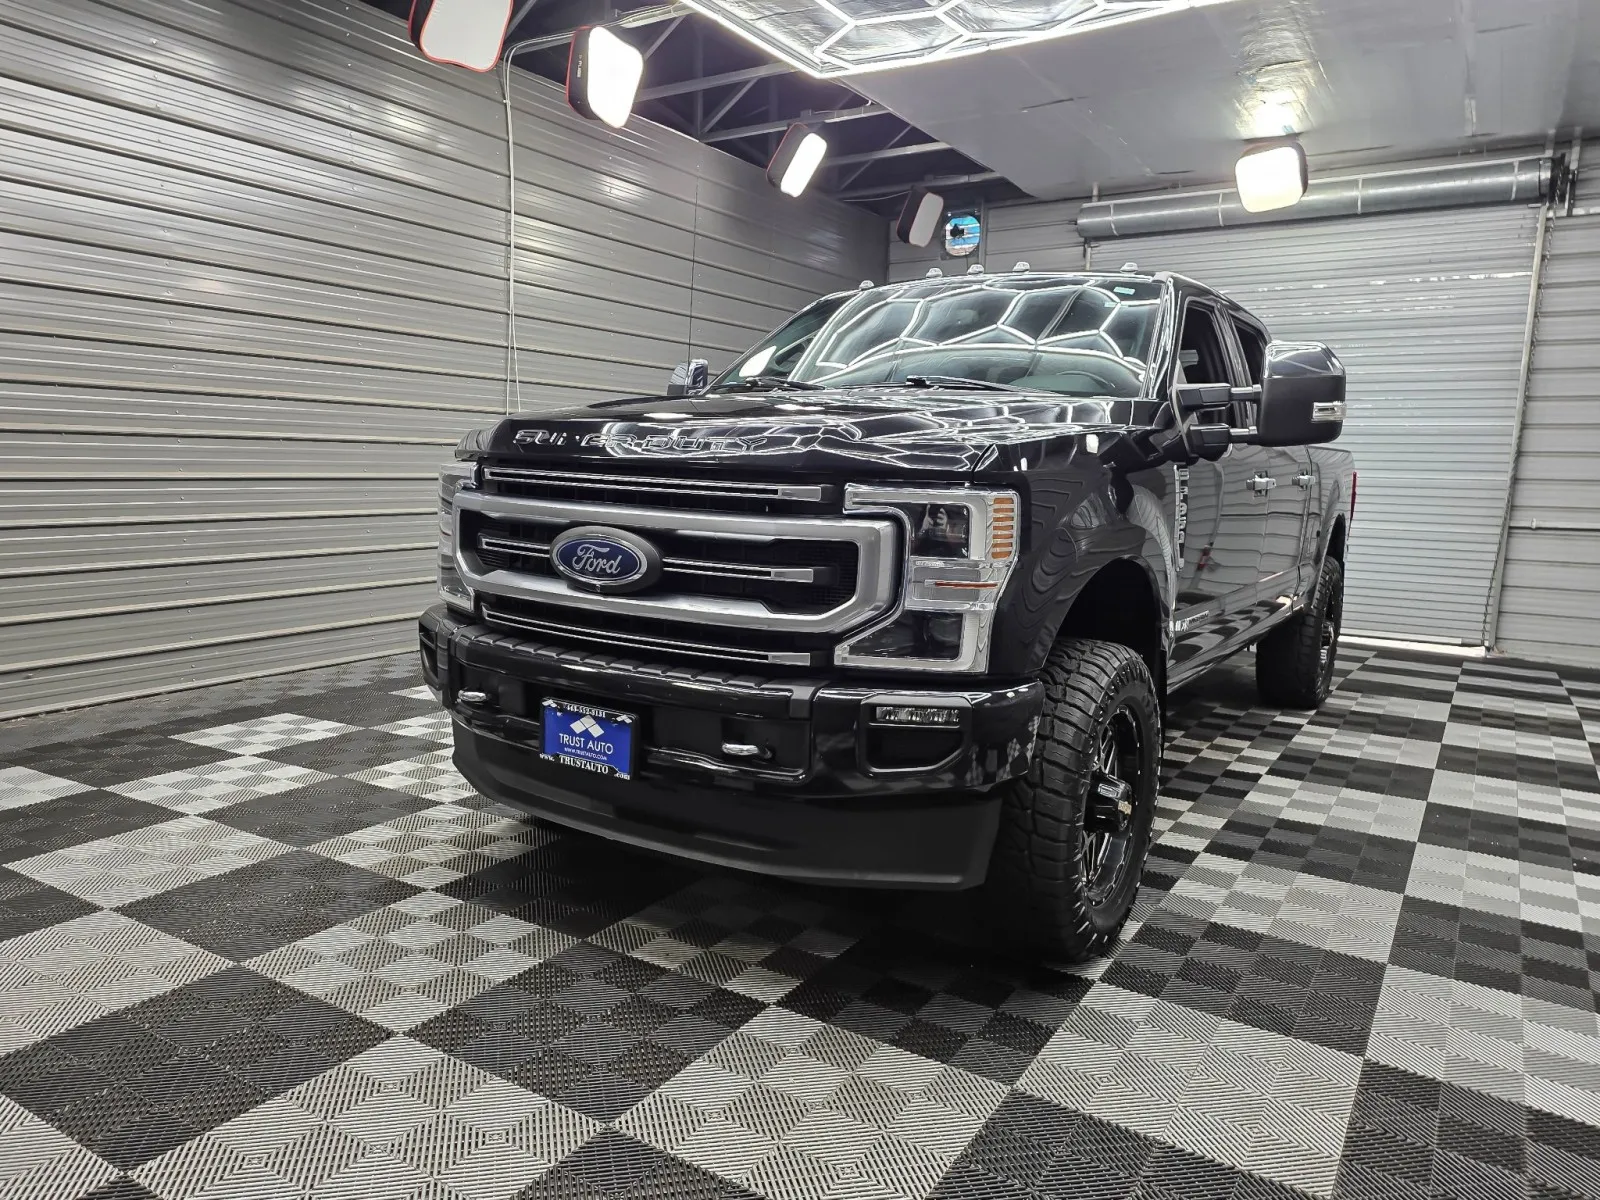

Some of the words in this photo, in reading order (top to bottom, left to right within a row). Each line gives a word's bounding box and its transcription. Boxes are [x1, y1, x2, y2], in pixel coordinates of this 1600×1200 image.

[643, 434, 767, 453] DUTY
[572, 544, 622, 574] Ford
[559, 733, 585, 748] TRUST
[587, 740, 614, 755] AUTO
[558, 755, 609, 774] TRUSTAUTO
